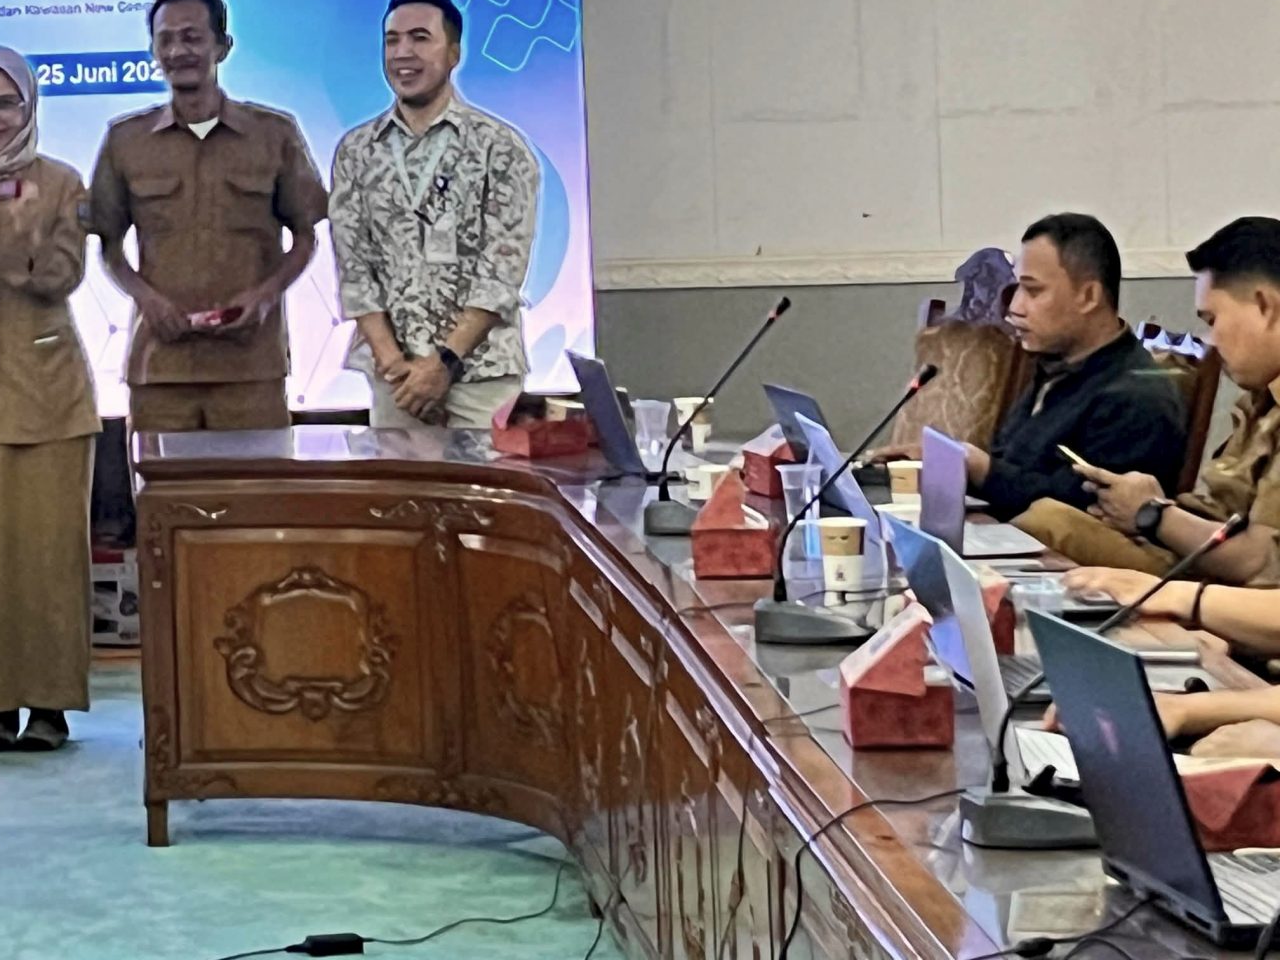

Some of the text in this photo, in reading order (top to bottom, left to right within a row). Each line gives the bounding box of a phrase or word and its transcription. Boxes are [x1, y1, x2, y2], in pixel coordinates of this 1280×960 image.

[37, 63, 66, 86] 25
[69, 60, 118, 84] Juni
[122, 60, 165, 83] 202
